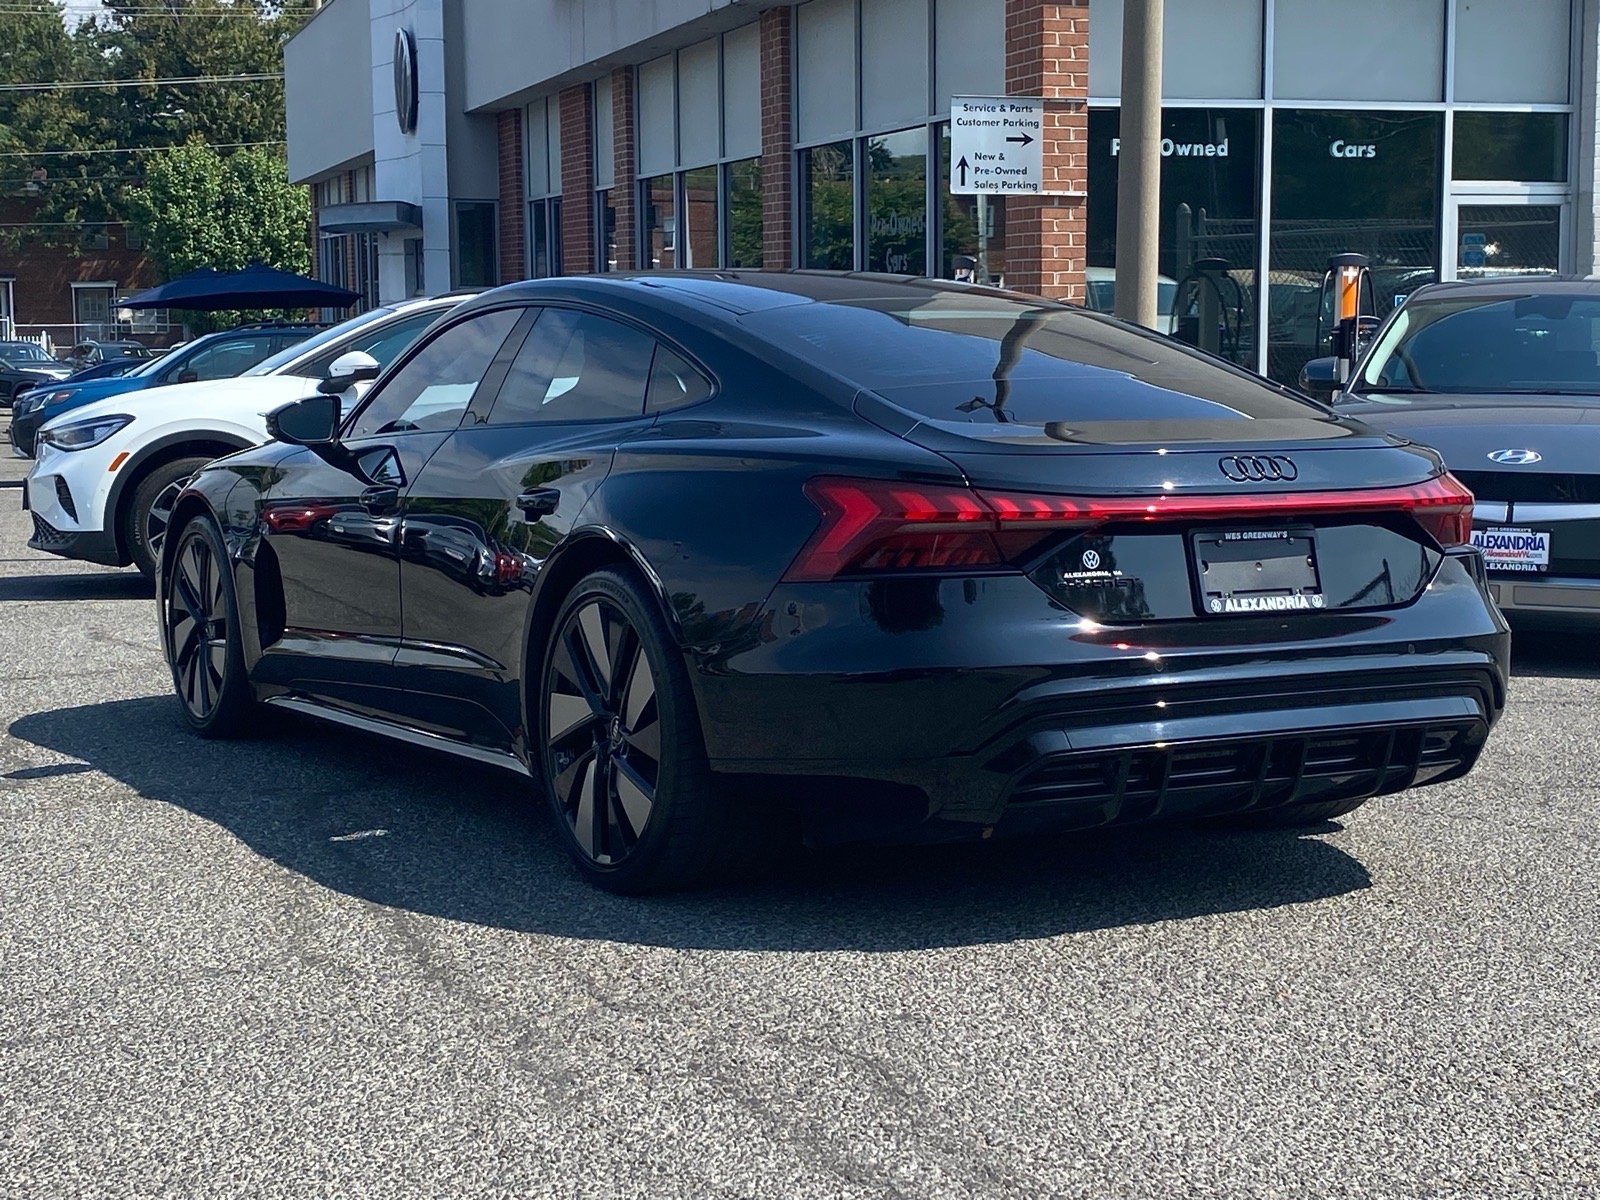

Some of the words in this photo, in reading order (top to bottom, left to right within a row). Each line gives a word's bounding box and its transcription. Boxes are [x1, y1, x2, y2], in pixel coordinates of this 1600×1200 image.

[963, 103, 996, 112] Service
[999, 104, 1006, 113] &
[1009, 104, 1033, 113] Parts
[956, 117, 1000, 127] Customer
[1003, 118, 1039, 129] Parking
[1330, 140, 1377, 158] Cars
[974, 152, 995, 161] New
[998, 152, 1005, 161] &
[974, 166, 1028, 175] Pre-Owned
[974, 180, 998, 189] Sales
[1001, 181, 1038, 191] Parking
[1225, 532, 1241, 540] WES
[1242, 531, 1288, 539] GREENWAY'S
[1473, 534, 1546, 551] ALEXANDRIA
[1224, 595, 1310, 612] ALEXANDRIA
